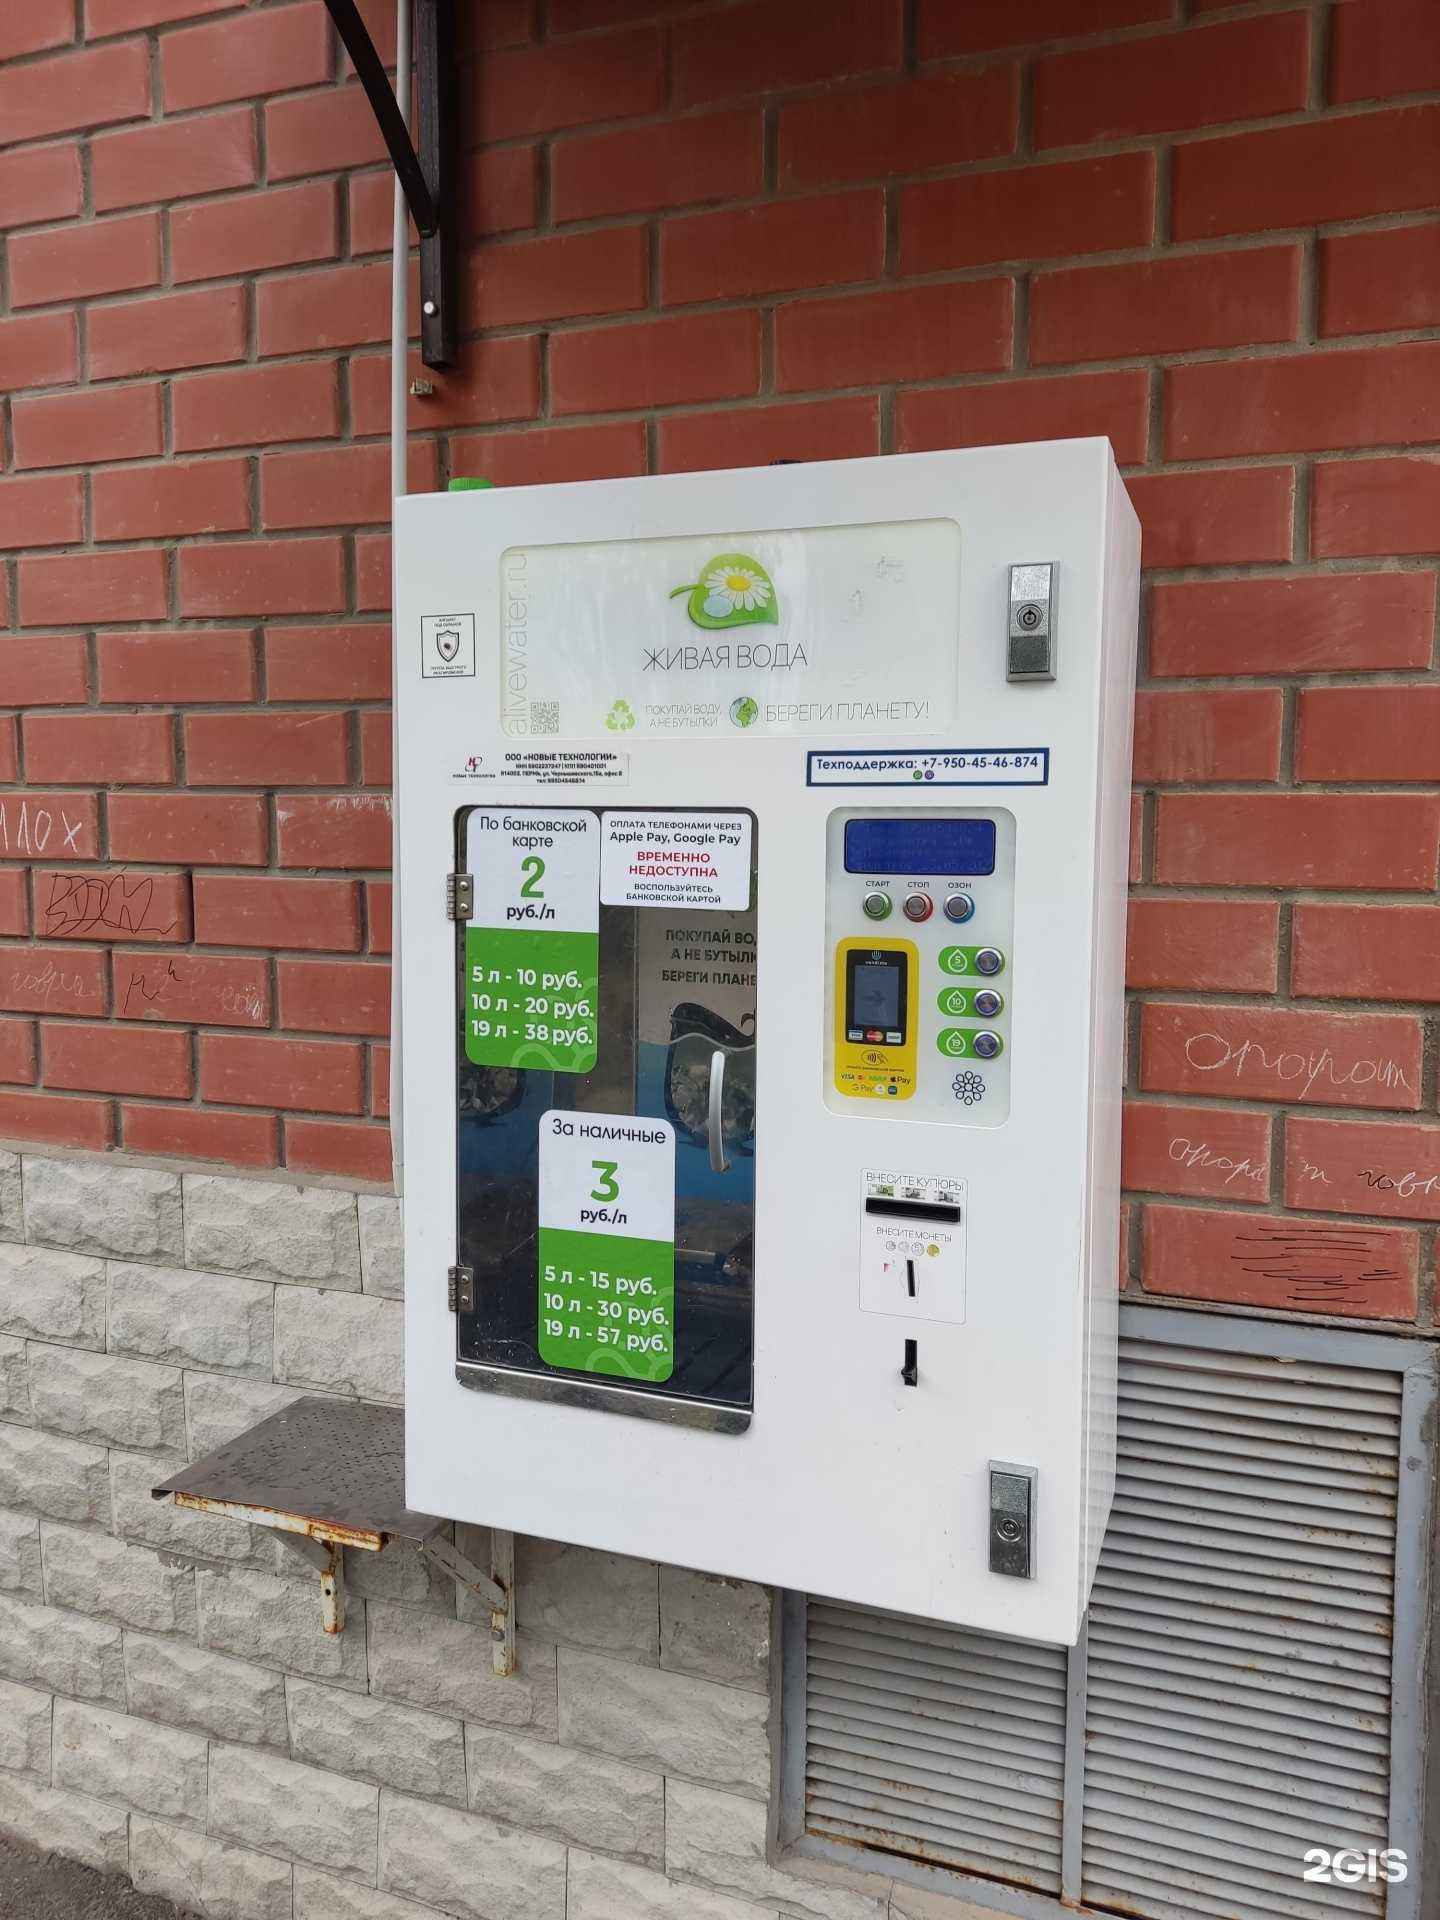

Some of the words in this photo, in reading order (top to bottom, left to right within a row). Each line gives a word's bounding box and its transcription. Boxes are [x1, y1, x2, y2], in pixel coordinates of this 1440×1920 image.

[503, 553, 528, 735] alivewater.ru
[642, 646, 730, 671] ЖИВАЯ
[736, 643, 808, 671] ВОДА
[646, 703, 692, 715] ПОКУПАЙ
[765, 704, 833, 722] БЕРЕГИ
[837, 701, 930, 721] ПЛАНЕТУ!
[673, 717, 718, 728] БУТЫЛКИ
[505, 753, 522, 761] ООО
[523, 753, 557, 761] «НОВЫЕ
[558, 752, 618, 761] ТЕХНОЛОГИИ»
[816, 758, 918, 772] Техподдержка:
[921, 756, 1039, 770] +7-950-45-46-874
[480, 816, 499, 831] По
[503, 815, 587, 832] банковской
[610, 820, 646, 829] ОПЛАТА
[648, 821, 711, 830] ТЕЛЕФОНАМИ
[713, 822, 742, 831] ЧЕРЕЗ
[512, 836, 554, 850] карте
[610, 831, 644, 844] Apple
[646, 832, 670, 844] Pay,
[673, 833, 715, 846] Google
[719, 834, 741, 846] Pay
[637, 851, 711, 863] ВРЕМЕННО
[520, 856, 546, 898] 2
[629, 865, 719, 878] НЕДОСТУПНА
[634, 883, 713, 893] ВОСПОЛЬЗУЙТЕСЬ
[865, 880, 891, 888] СТАРТ
[947, 881, 972, 889] ОЗОН
[626, 892, 685, 903] БАНКОВСКОЙ
[686, 895, 721, 904] КАРТОЙ
[506, 903, 555, 920] руб./л
[666, 929, 731, 944] ПОКУПАЙ
[734, 932, 757, 947] ВО
[671, 948, 680, 960] А
[684, 948, 701, 960] НЕ
[472, 966, 483, 983] 5
[487, 970, 500, 984] л
[517, 968, 537, 985] 10
[542, 970, 582, 991] руб.
[662, 969, 709, 984] БЕРЕГИ
[472, 994, 491, 1011] 10
[495, 997, 508, 1011] л
[525, 997, 548, 1014] 20
[553, 1000, 594, 1020] руб.
[952, 997, 961, 1006] 10
[472, 1020, 491, 1037] 19
[494, 1024, 507, 1038] л
[525, 1024, 548, 1041] 38
[552, 1026, 593, 1047] руб.
[552, 1118, 574, 1136] За
[579, 1125, 667, 1145] наличные
[590, 1160, 620, 1202] 3
[866, 1172, 914, 1186] ВНЕСИТЕ
[916, 1177, 964, 1191] КУПЮРЫ
[580, 1208, 627, 1225] руб./л
[876, 1226, 914, 1239] ВНЕСИТЕ
[914, 1230, 952, 1243] МОНЕТЫ
[544, 1265, 556, 1282] 5
[560, 1269, 573, 1284] л
[590, 1270, 610, 1289] 15
[615, 1275, 658, 1296] руб.
[544, 1293, 564, 1310] 10
[568, 1298, 581, 1312] л
[597, 1300, 622, 1318] 30
[627, 1305, 670, 1326] руб.
[543, 1319, 564, 1336] 19
[567, 1324, 580, 1339] л
[597, 1327, 621, 1345] 57
[626, 1332, 669, 1353] руб.
